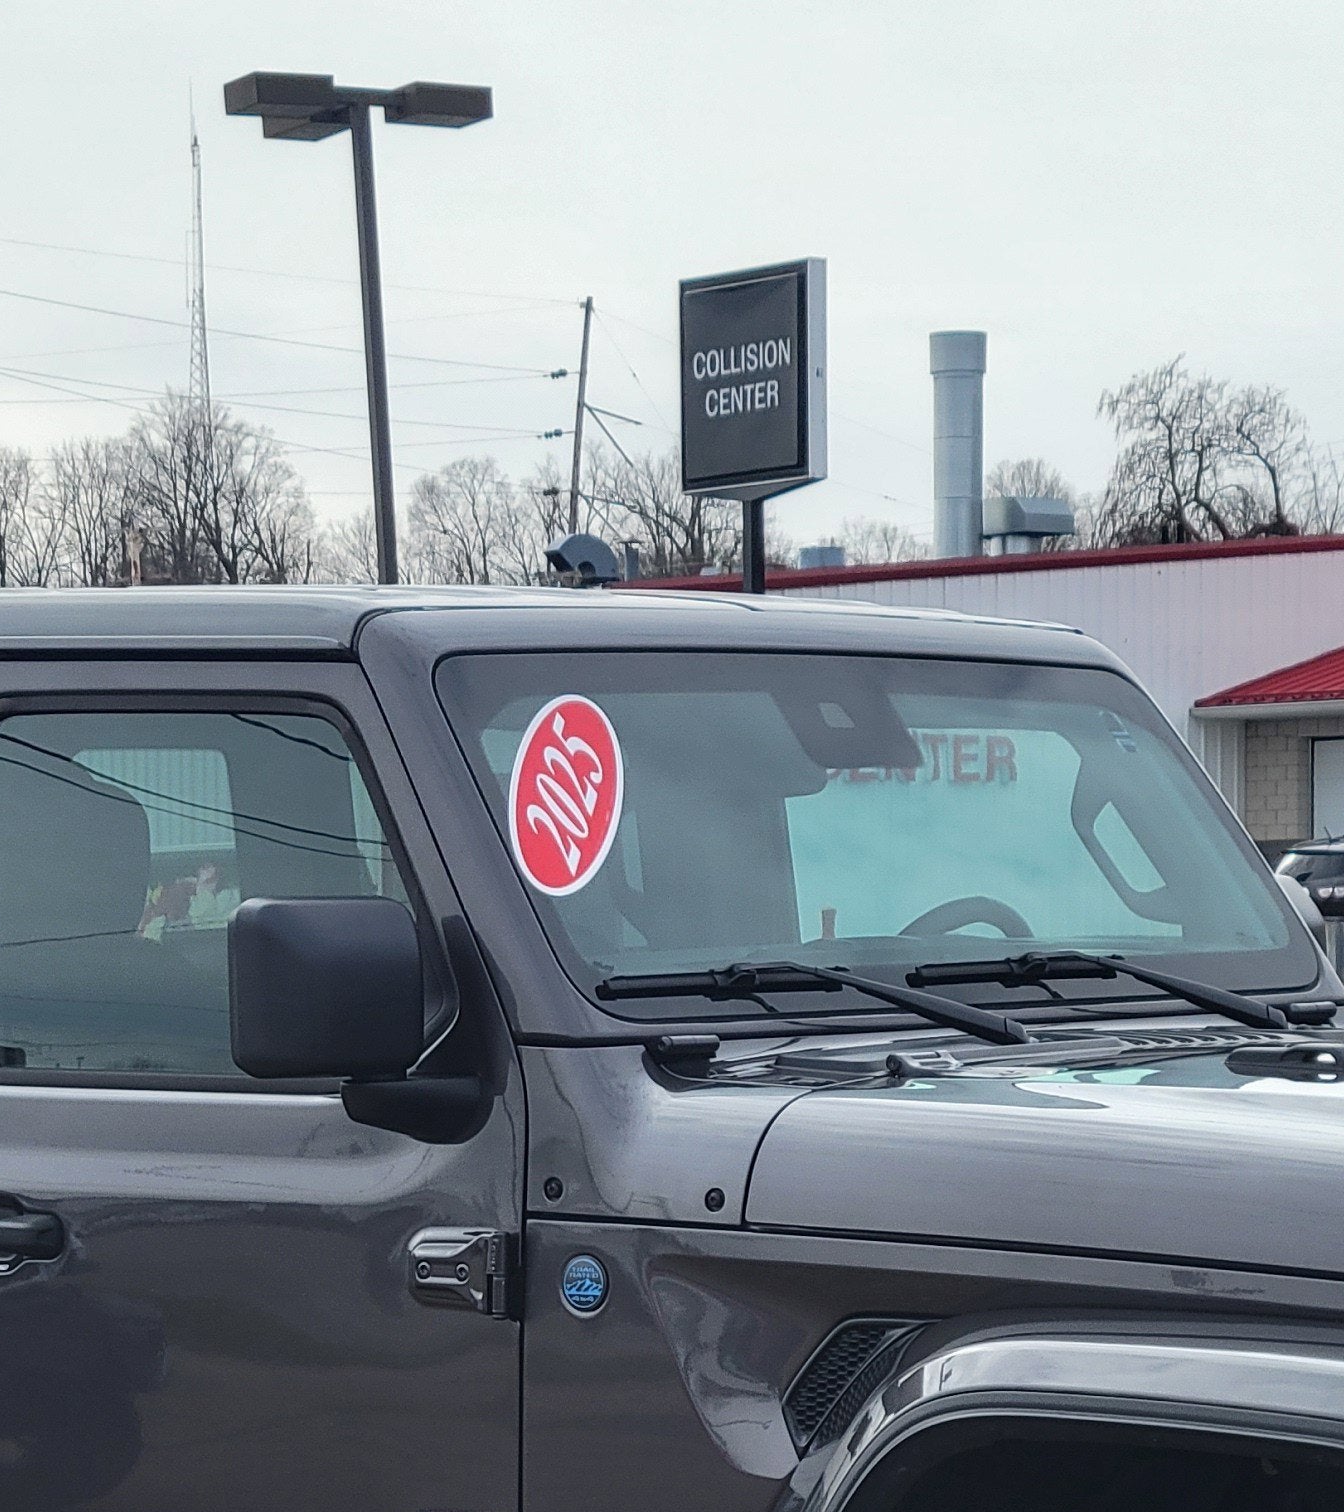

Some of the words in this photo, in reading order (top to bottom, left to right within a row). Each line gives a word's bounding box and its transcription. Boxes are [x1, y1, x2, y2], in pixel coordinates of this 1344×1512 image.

[693, 337, 791, 380] COLLISION
[705, 380, 779, 417] CENTER
[526, 711, 603, 878] 2025
